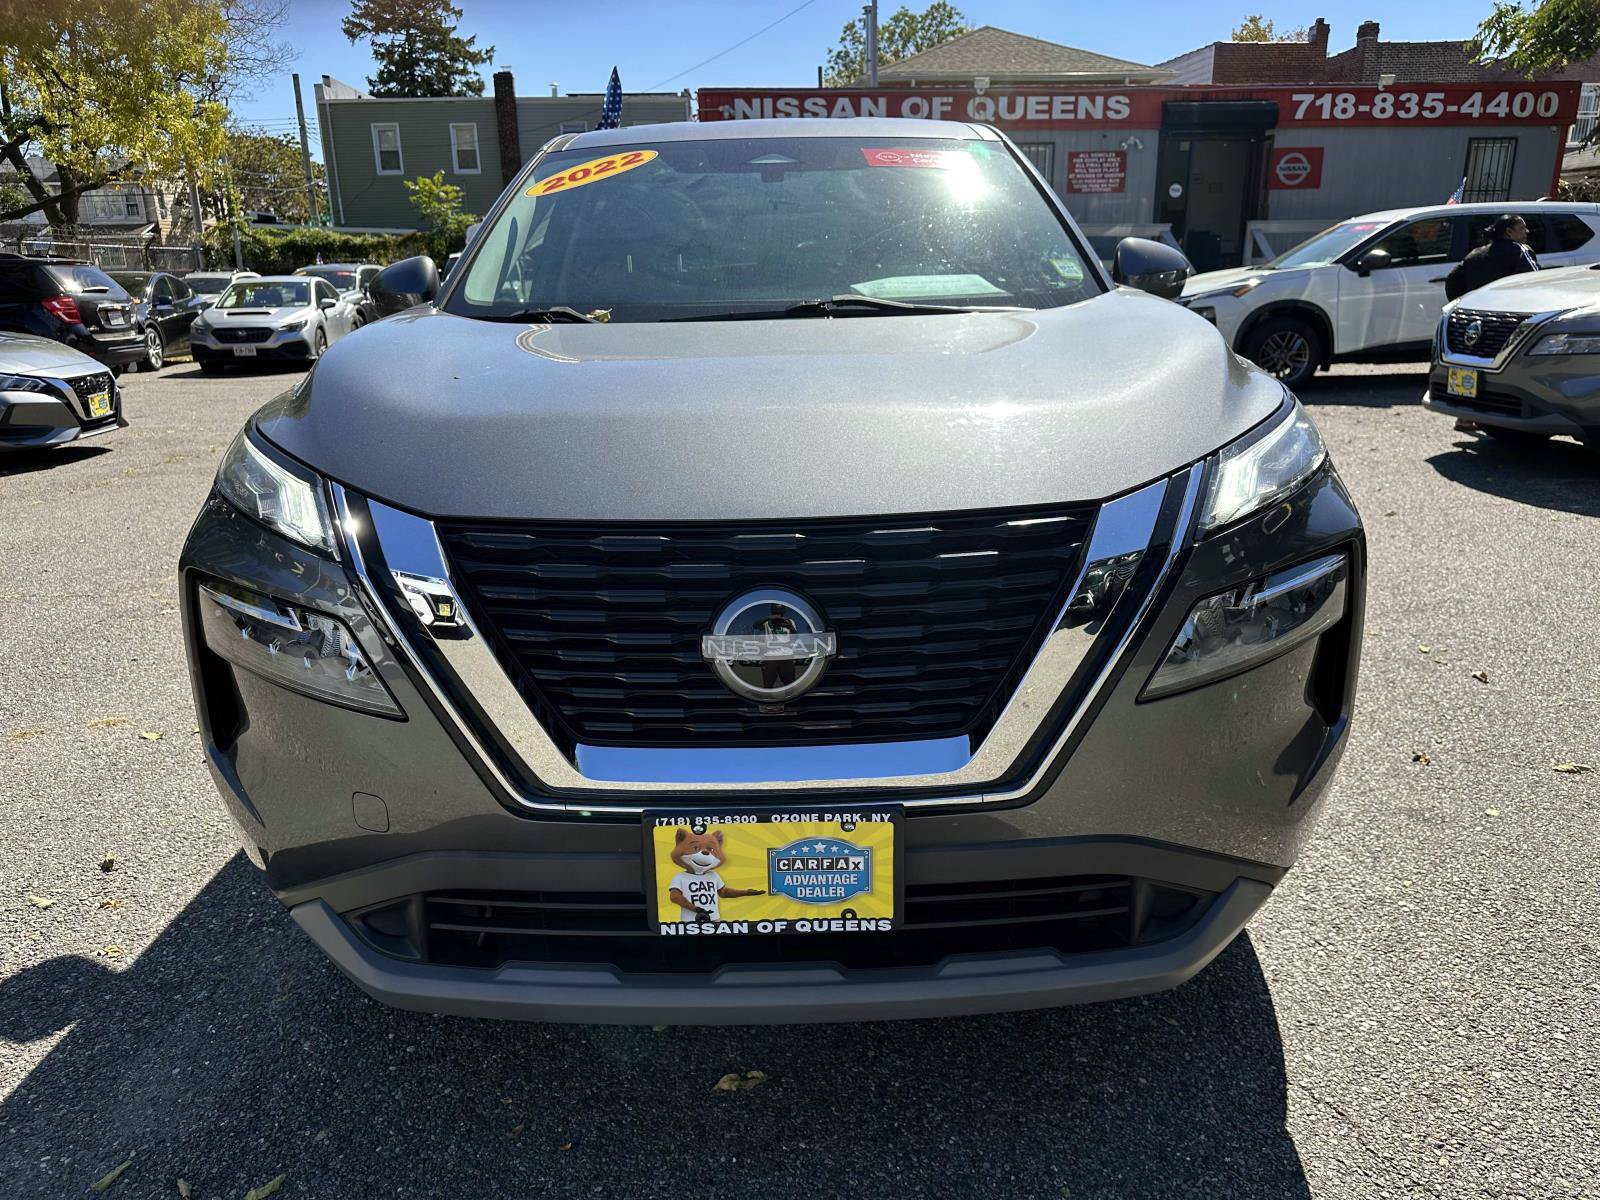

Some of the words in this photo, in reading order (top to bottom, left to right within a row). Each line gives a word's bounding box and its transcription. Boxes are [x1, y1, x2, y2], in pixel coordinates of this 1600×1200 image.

[734, 97, 878, 120] NISSAN
[901, 96, 953, 120] OF
[967, 95, 1131, 121] QUEENS
[1292, 91, 1560, 120] 718-835-4400
[542, 152, 645, 193] 2022
[706, 636, 833, 656] NISSAN
[655, 817, 691, 827] (718)
[695, 815, 758, 826] 835-8300
[771, 813, 819, 823] OZONE
[824, 813, 867, 823] PARK,
[871, 813, 891, 823] NY
[778, 858, 863, 871] CARFAX
[784, 873, 858, 886] ADVANTAGE
[688, 881, 715, 893] CAR
[797, 886, 845, 898] DEALER
[691, 893, 716, 905] FOX
[660, 922, 749, 936] NISSAN
[757, 921, 787, 934] OF
[796, 919, 892, 933] QUEENS
